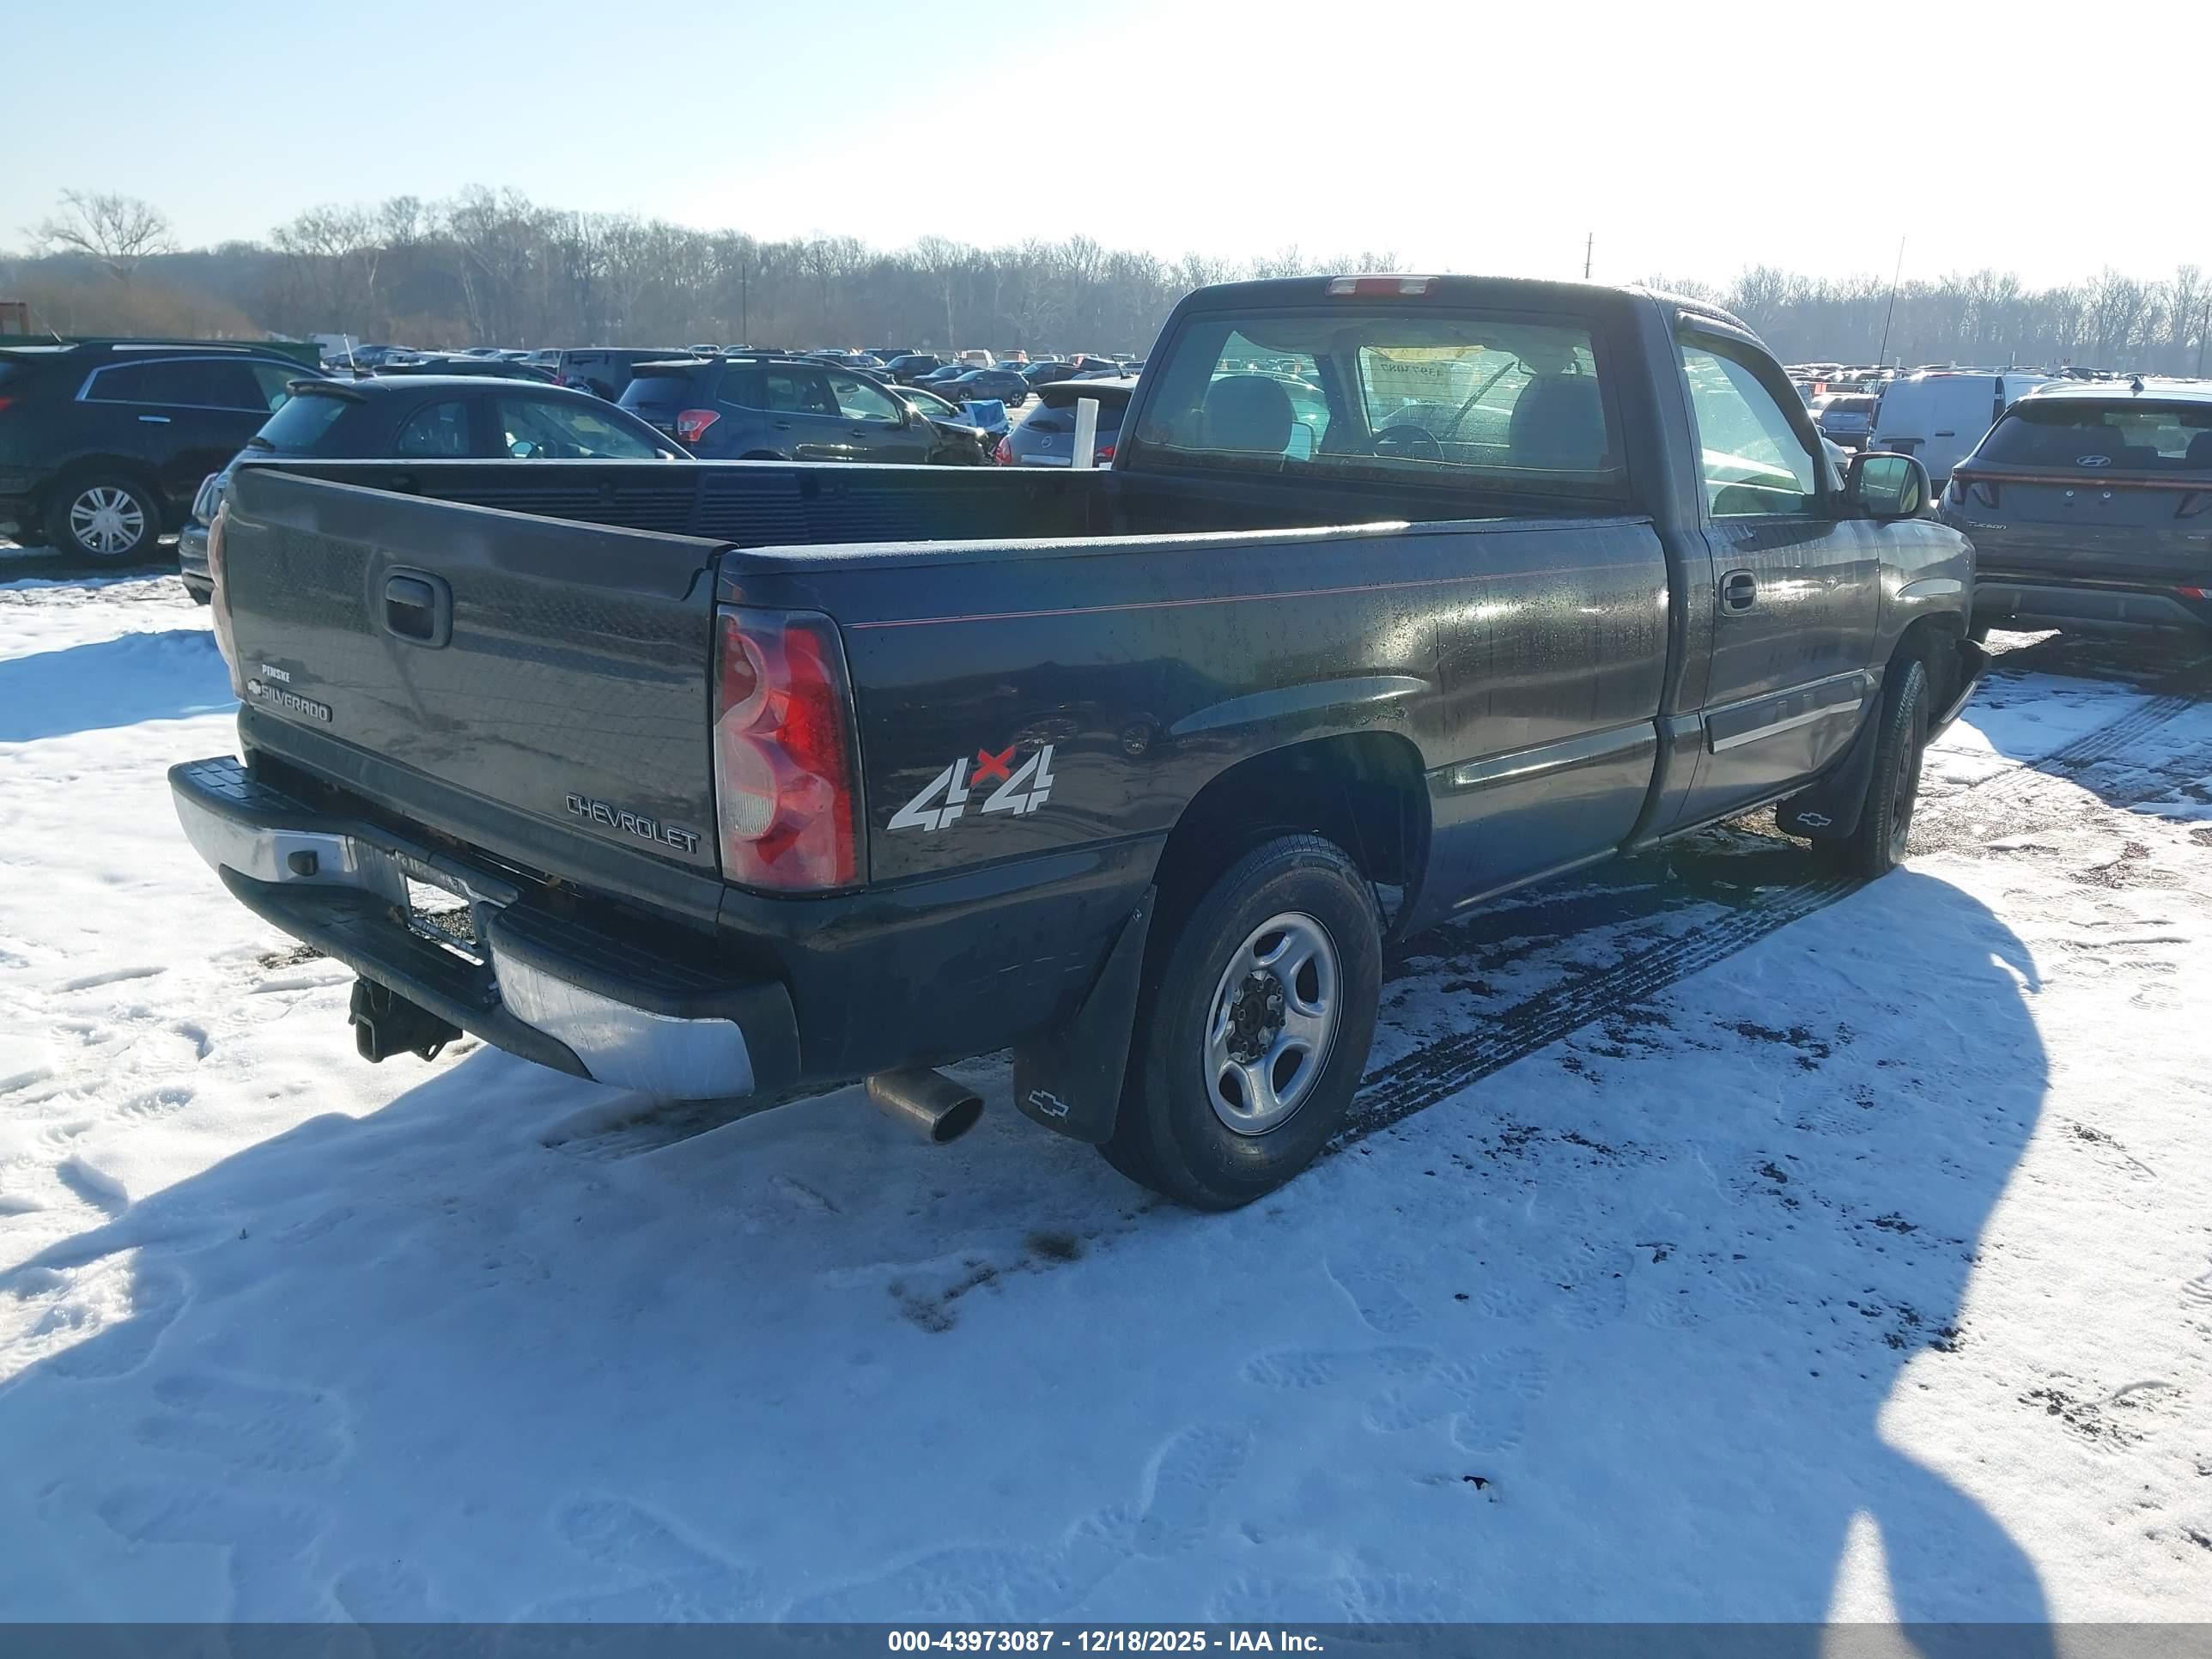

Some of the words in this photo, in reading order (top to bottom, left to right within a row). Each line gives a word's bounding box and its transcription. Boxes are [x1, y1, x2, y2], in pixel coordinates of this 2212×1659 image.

[261, 664, 291, 684] PENSKE
[261, 684, 330, 722] SILVERADO
[564, 793, 700, 854] CHEVROLET
